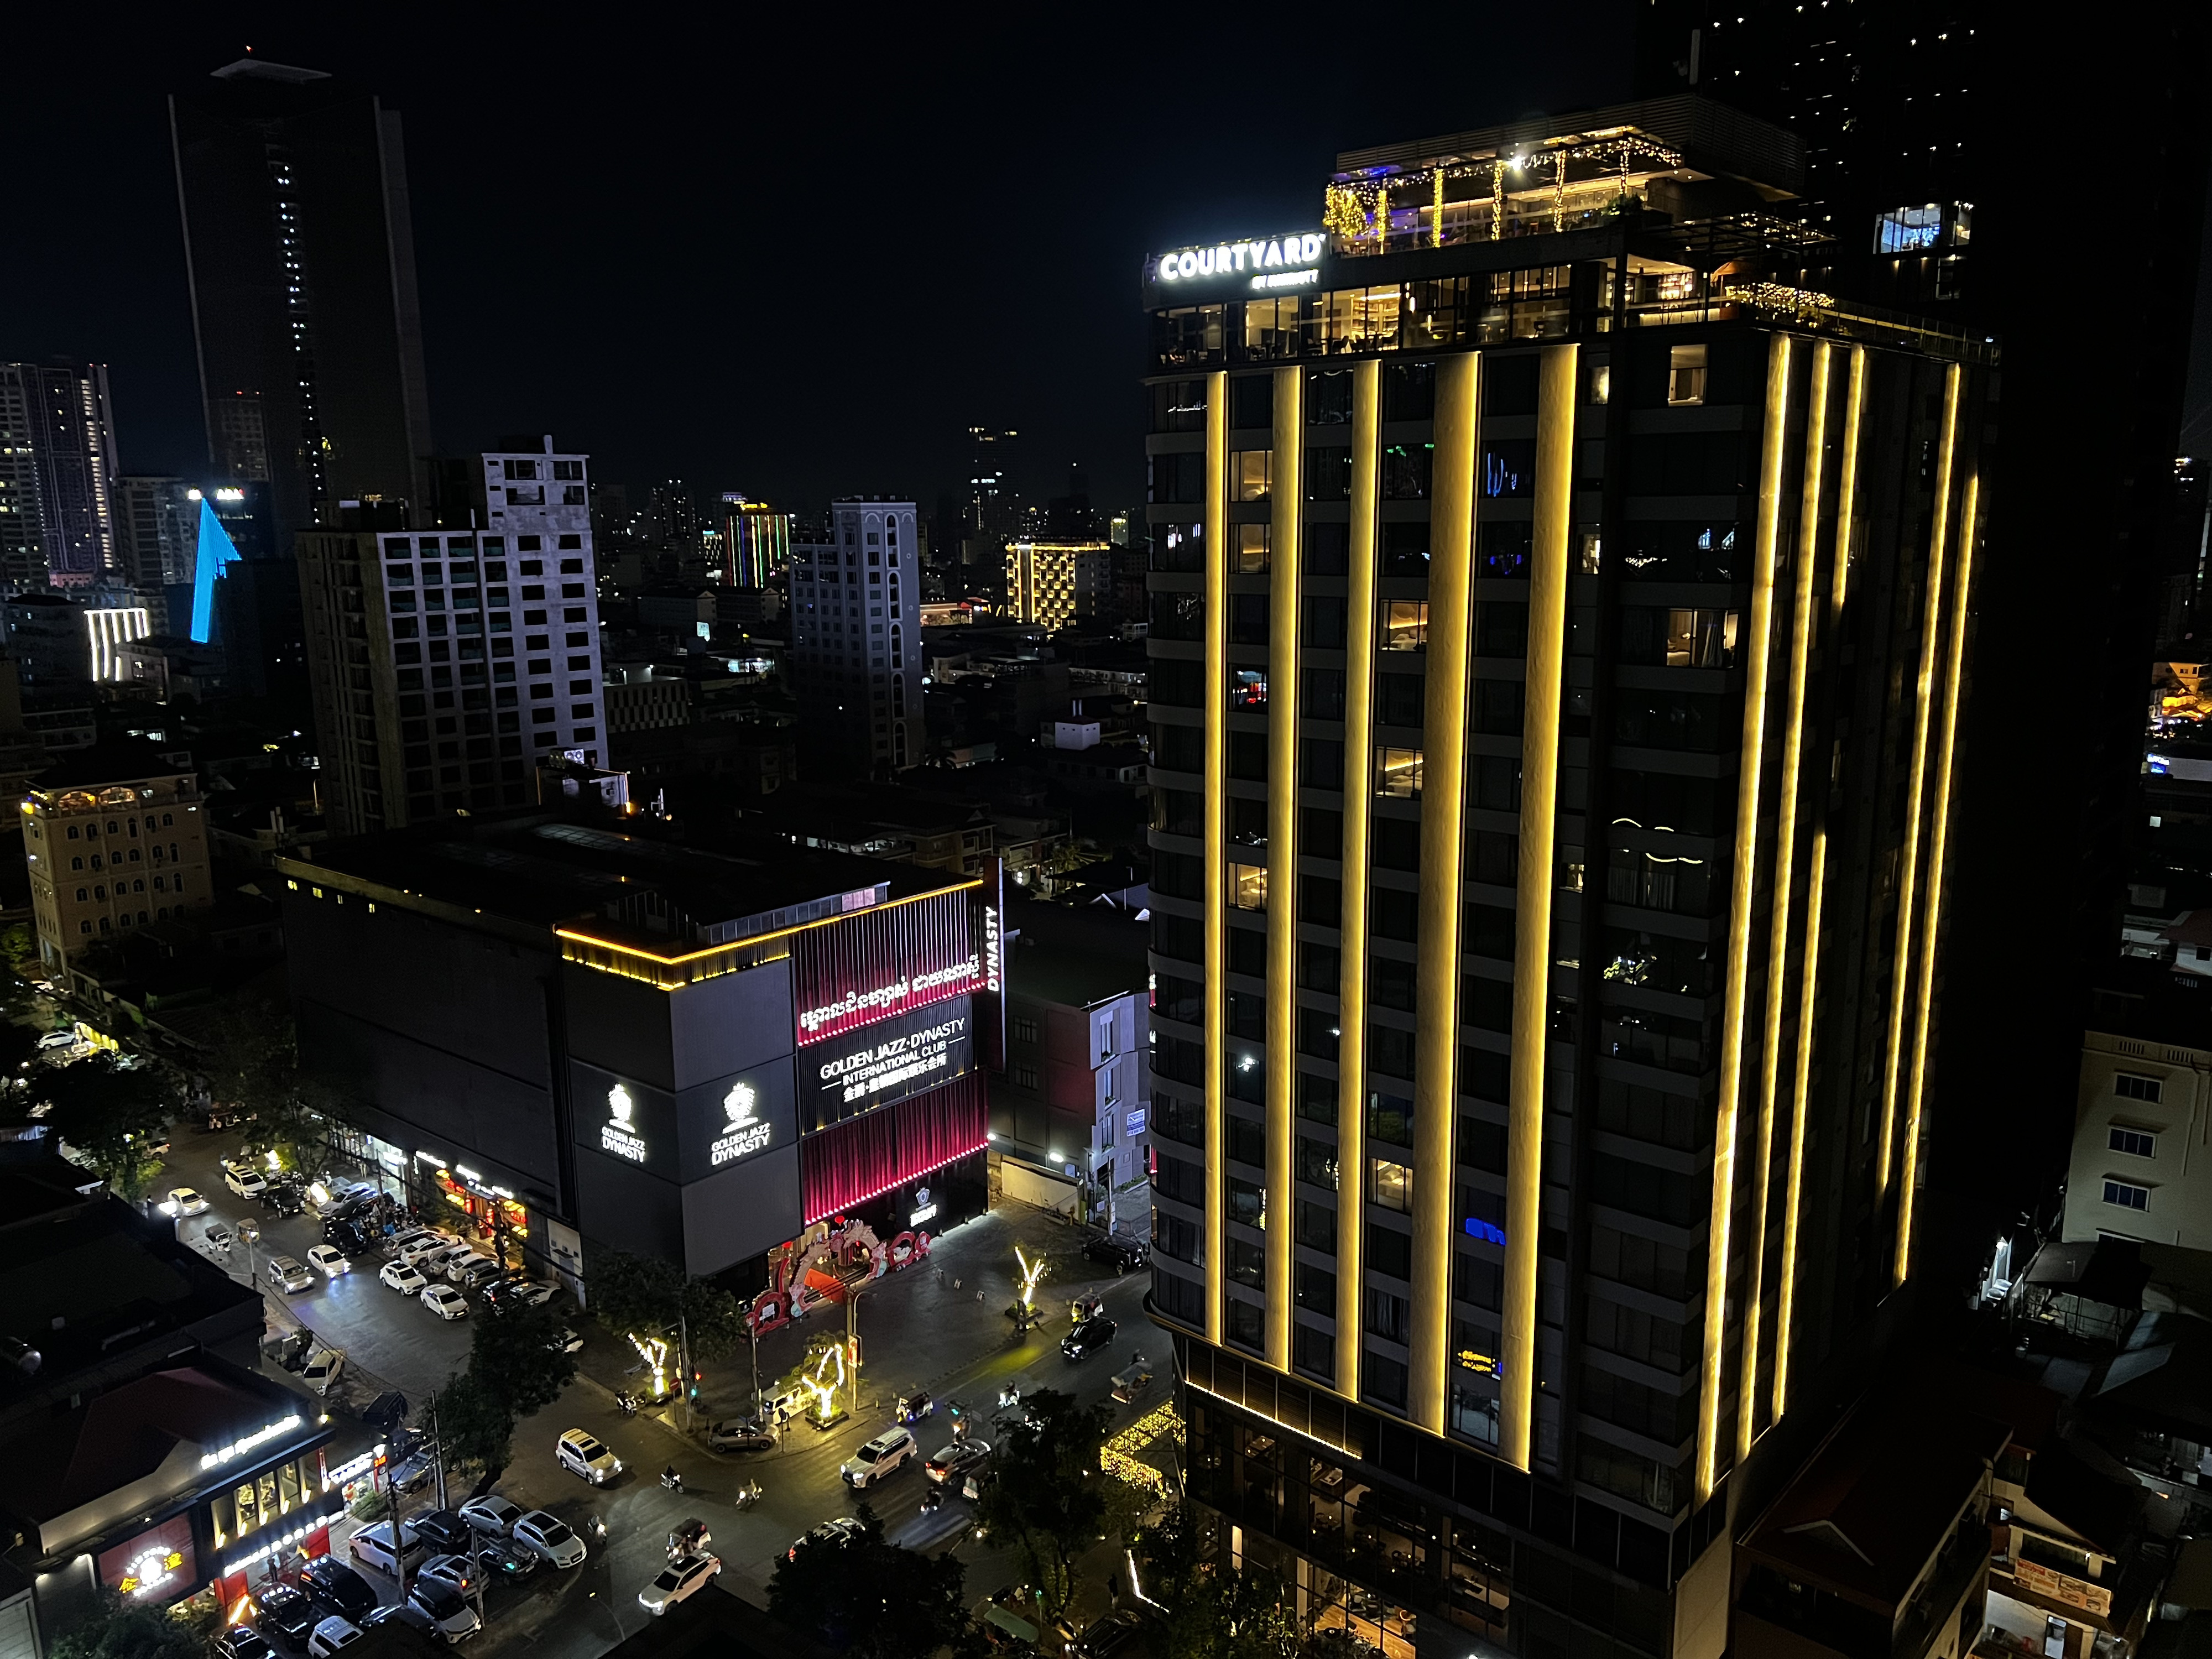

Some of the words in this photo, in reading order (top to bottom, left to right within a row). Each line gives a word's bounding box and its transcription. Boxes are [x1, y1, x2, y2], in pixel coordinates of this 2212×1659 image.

[1160, 234, 1322, 280] COURTYARD
[985, 906, 1000, 992] DYNASTY
[820, 1049, 873, 1079] GOLDEN
[843, 1050, 920, 1086] INTERNATIONAL
[921, 1040, 946, 1057] CLUB
[601, 1126, 628, 1144] GOLDEN
[628, 1136, 645, 1151] JAZZ
[602, 1135, 646, 1162] DYNASTY
[711, 1132, 747, 1152] GOLDEN
[747, 1123, 770, 1140] JAZZ
[711, 1133, 771, 1166] DYNASTY
